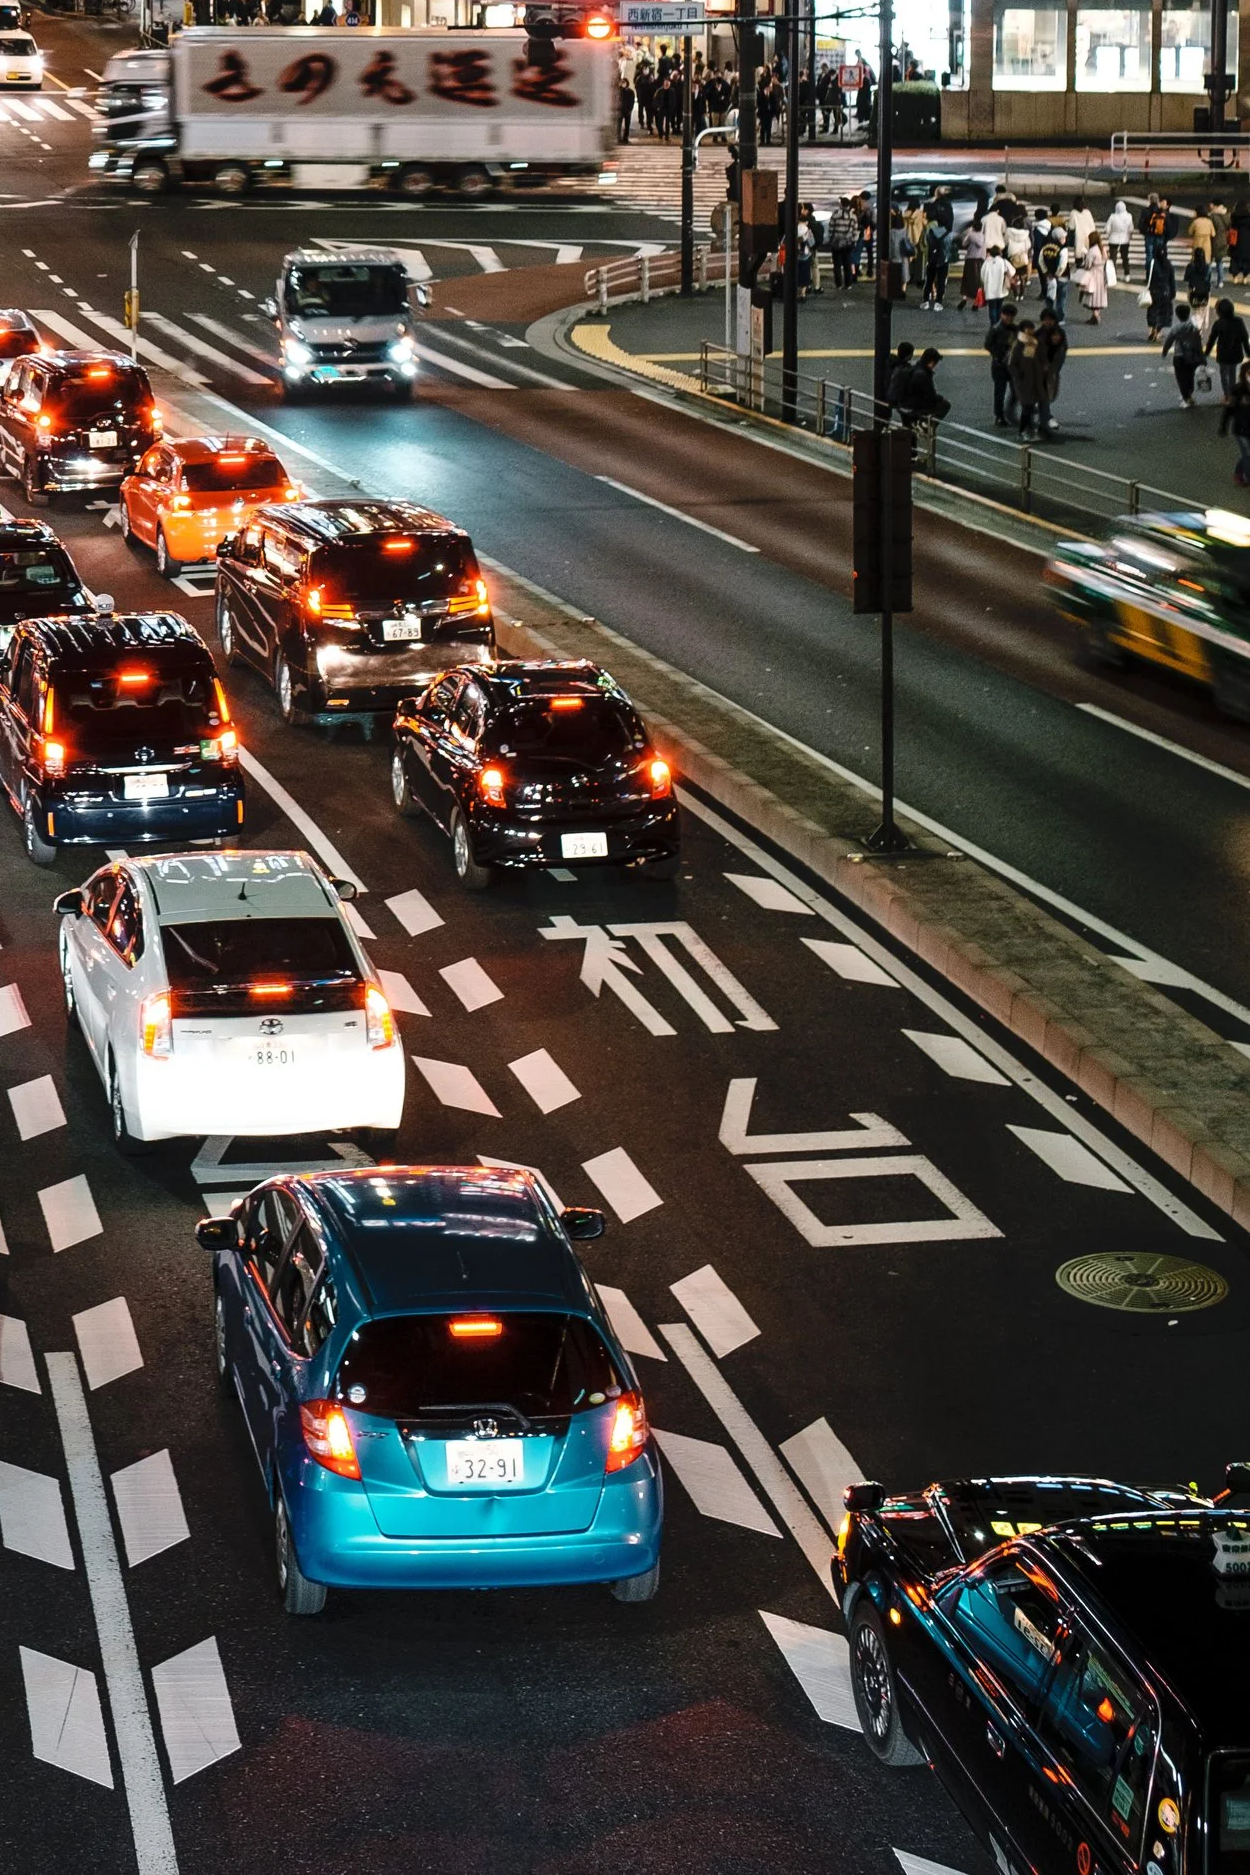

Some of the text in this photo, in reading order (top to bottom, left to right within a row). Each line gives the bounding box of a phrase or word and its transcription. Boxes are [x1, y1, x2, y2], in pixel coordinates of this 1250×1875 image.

[628, 7, 698, 22] 西新宿一丁目
[256, 1049, 295, 1065] 88-01
[464, 1457, 516, 1479] 32-91
[1225, 1562, 1250, 1573] 500
